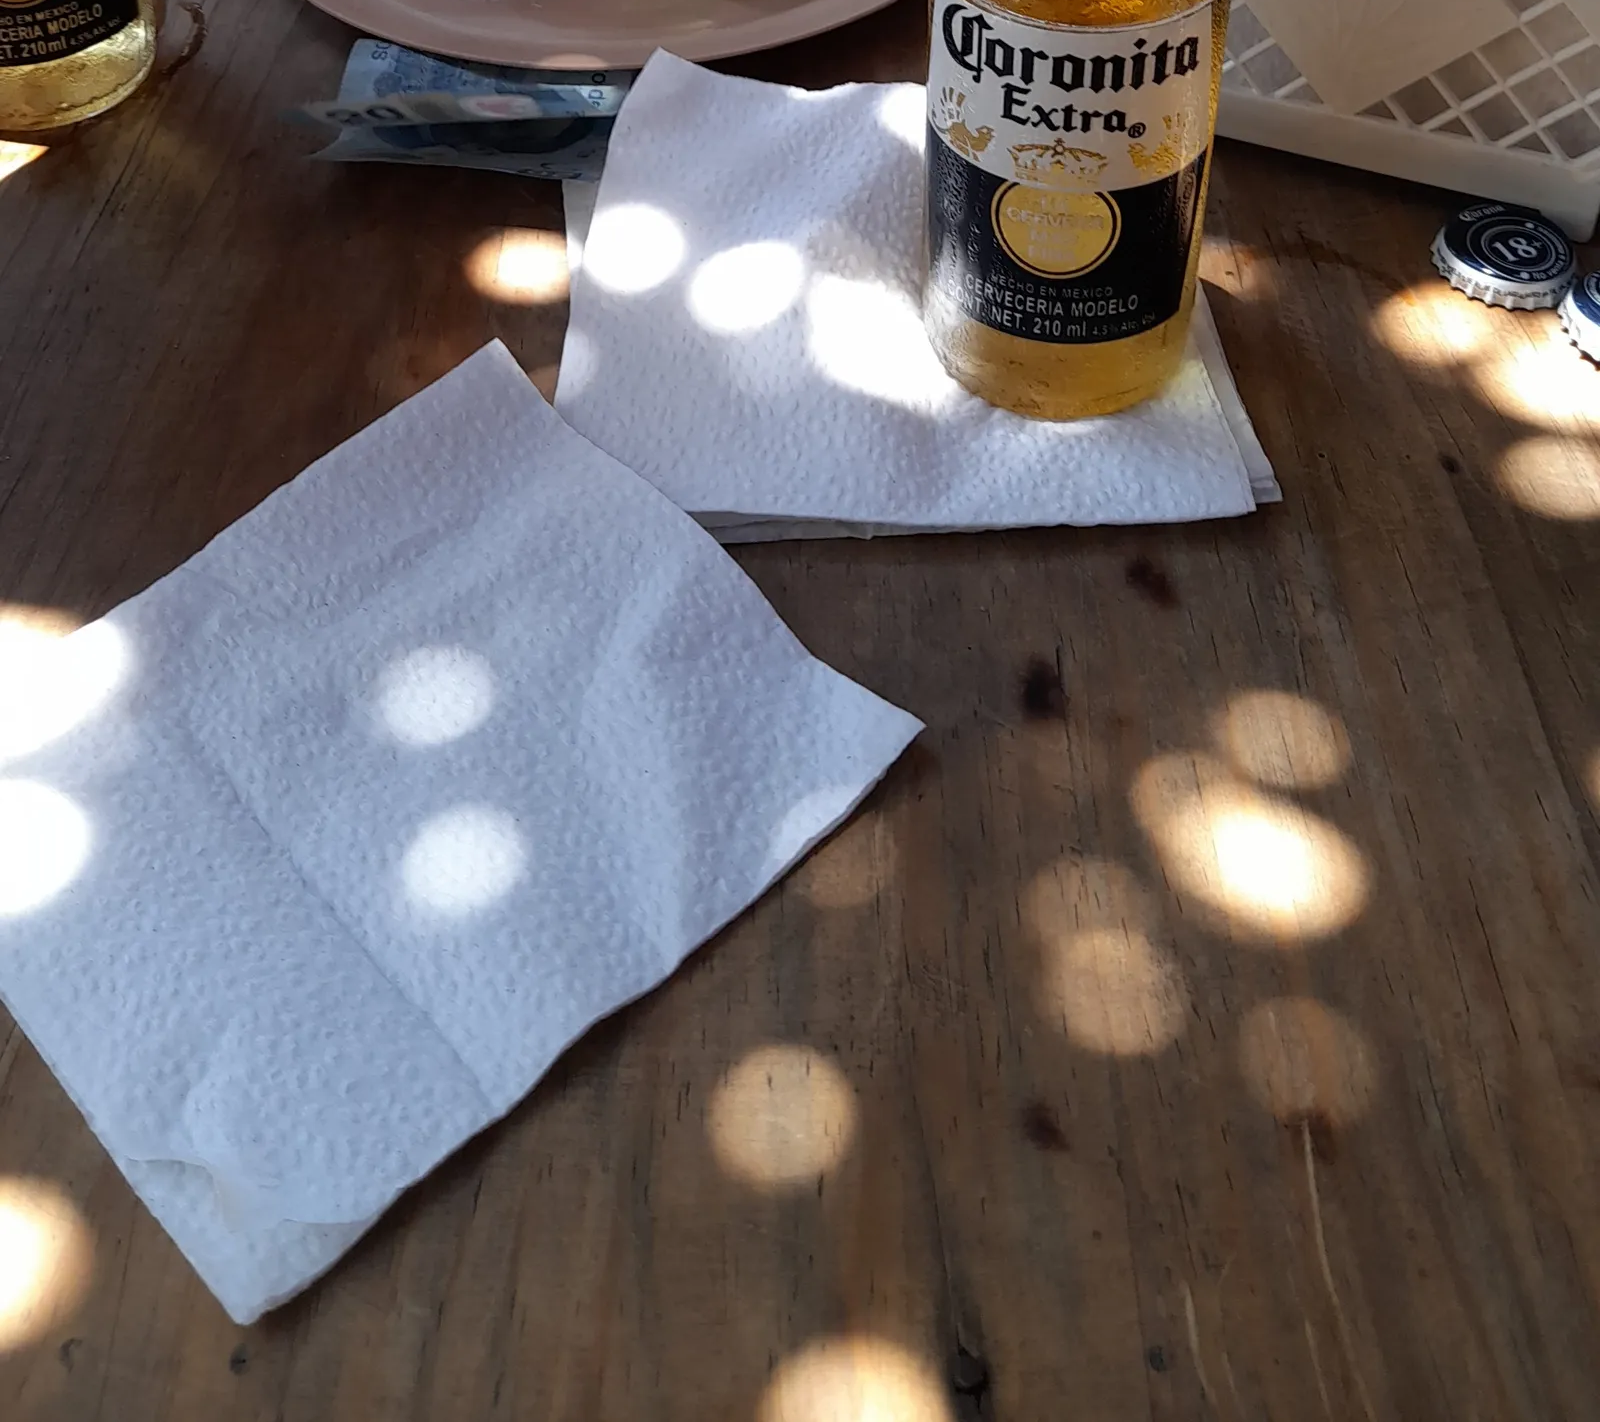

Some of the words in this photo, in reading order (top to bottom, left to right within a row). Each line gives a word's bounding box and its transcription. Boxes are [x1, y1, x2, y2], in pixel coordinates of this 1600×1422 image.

[0, 24, 45, 42] CERIA
[47, 3, 102, 35] MODELO
[35, 1, 79, 21] MEXICO
[942, 3, 1200, 94] Coronita
[1458, 203, 1506, 222] Corona
[965, 273, 1065, 317] CERVECERIA
[1070, 293, 1139, 318] MODELO
[1039, 285, 1057, 298] EN
[1062, 286, 1114, 299] MEXICO
[990, 307, 1026, 331] NET.
[1033, 317, 1062, 337] 210
[1066, 320, 1087, 338] ml
